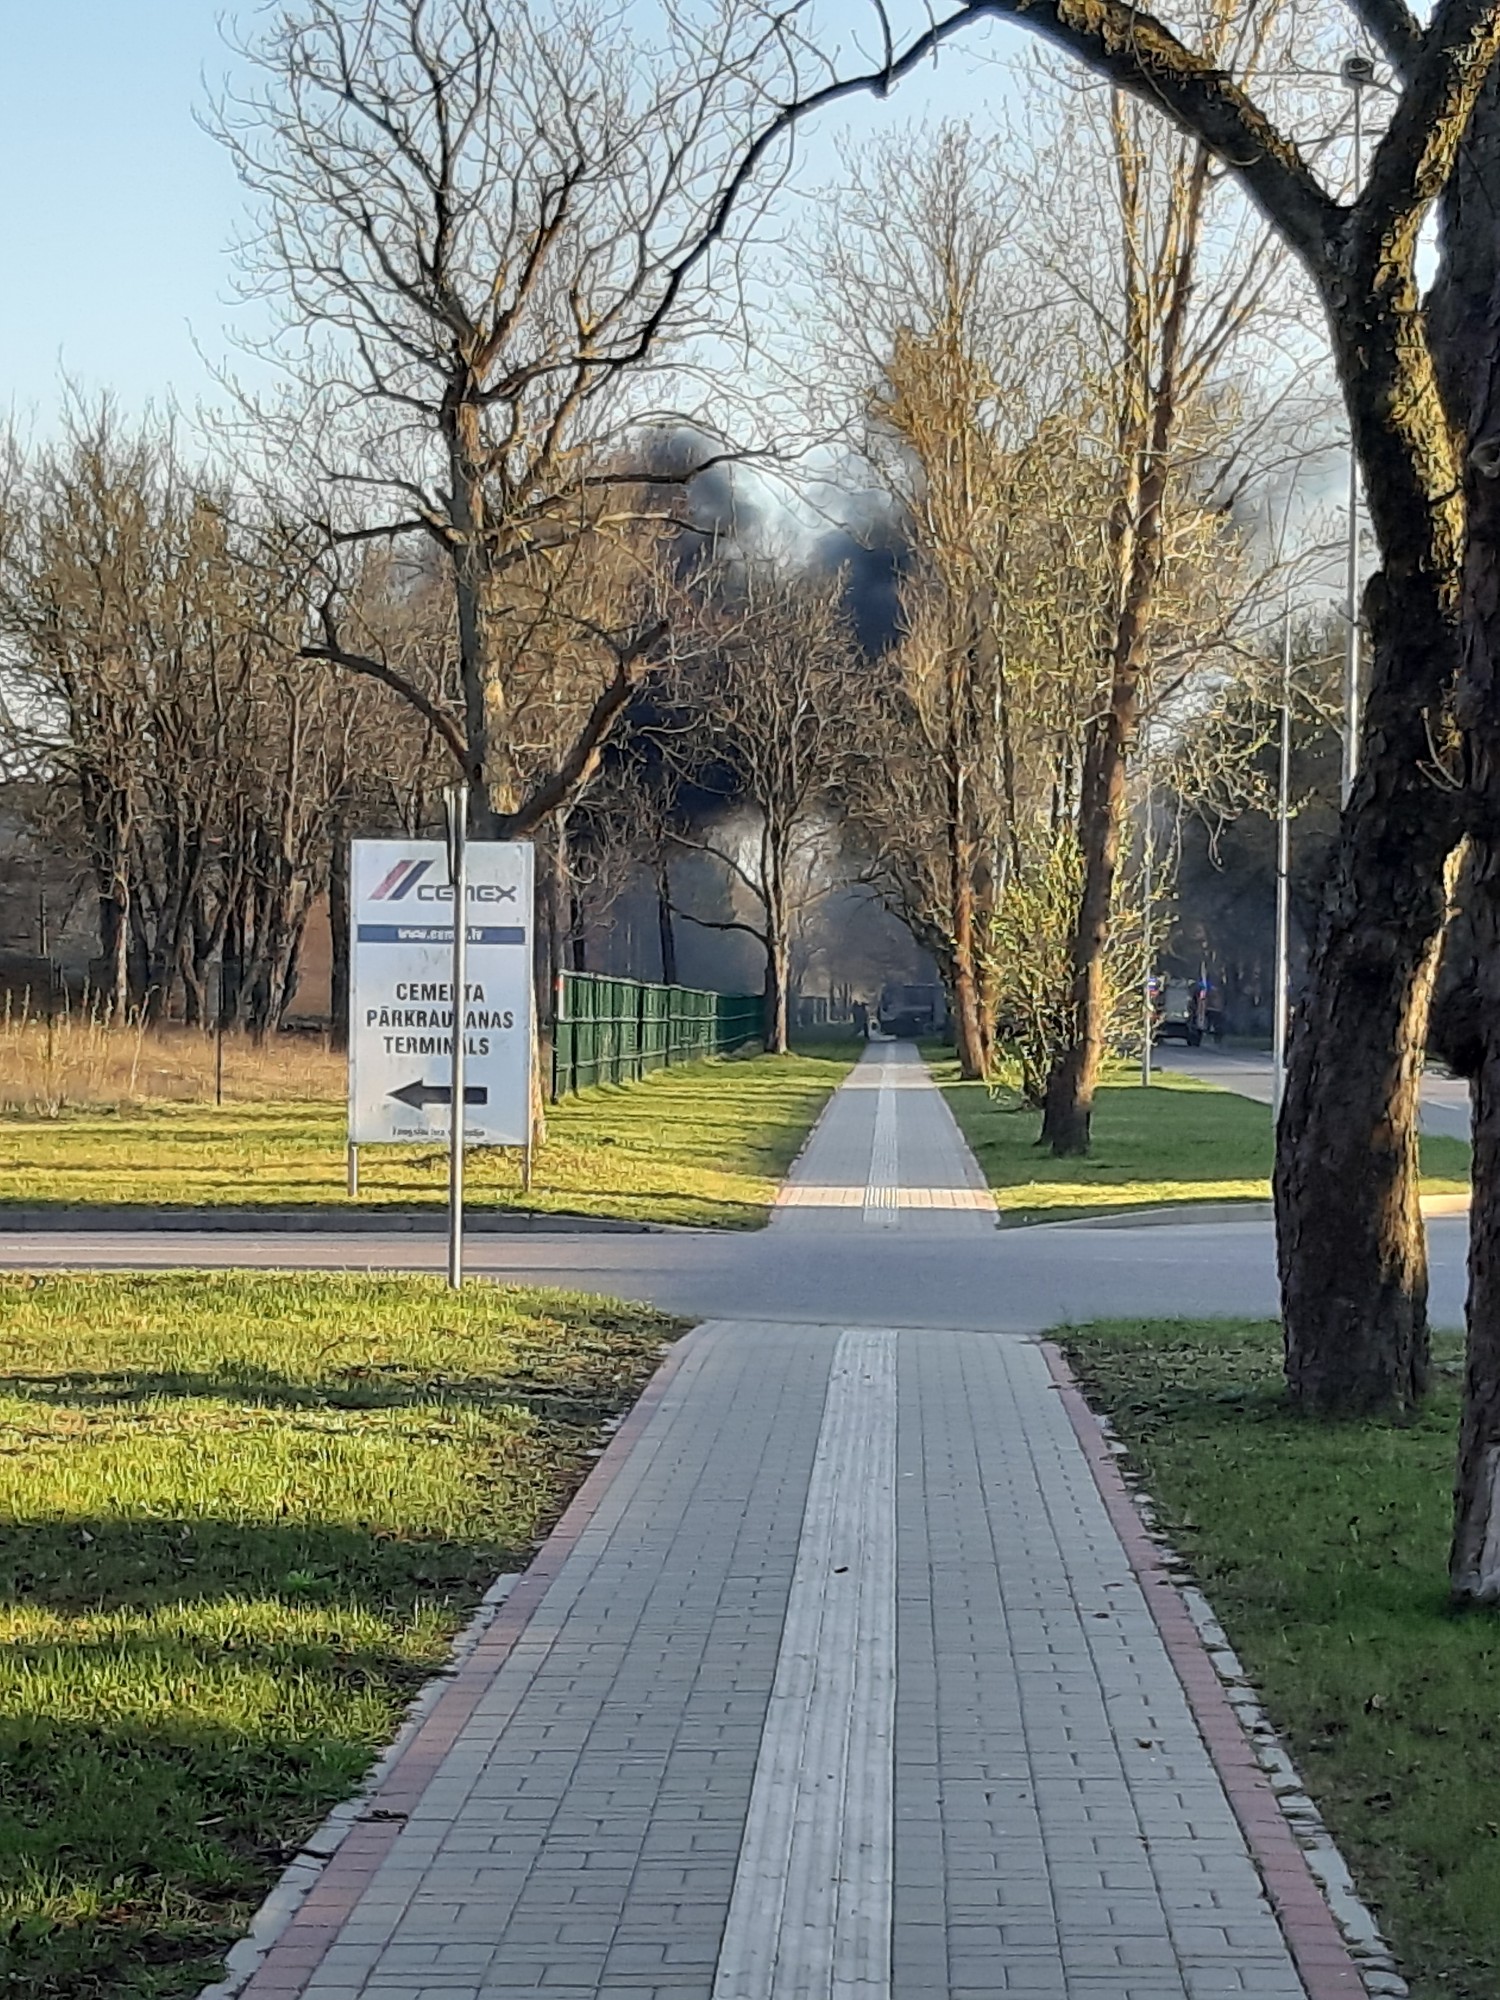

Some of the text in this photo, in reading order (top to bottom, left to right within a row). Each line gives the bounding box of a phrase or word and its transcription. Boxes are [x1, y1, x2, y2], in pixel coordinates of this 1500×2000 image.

[398, 927, 483, 942] www.cem.lv
[396, 983, 485, 1003] CEMETA
[366, 1006, 514, 1028] PĀRKRAUANAS
[383, 1036, 490, 1055] TERMINLS
